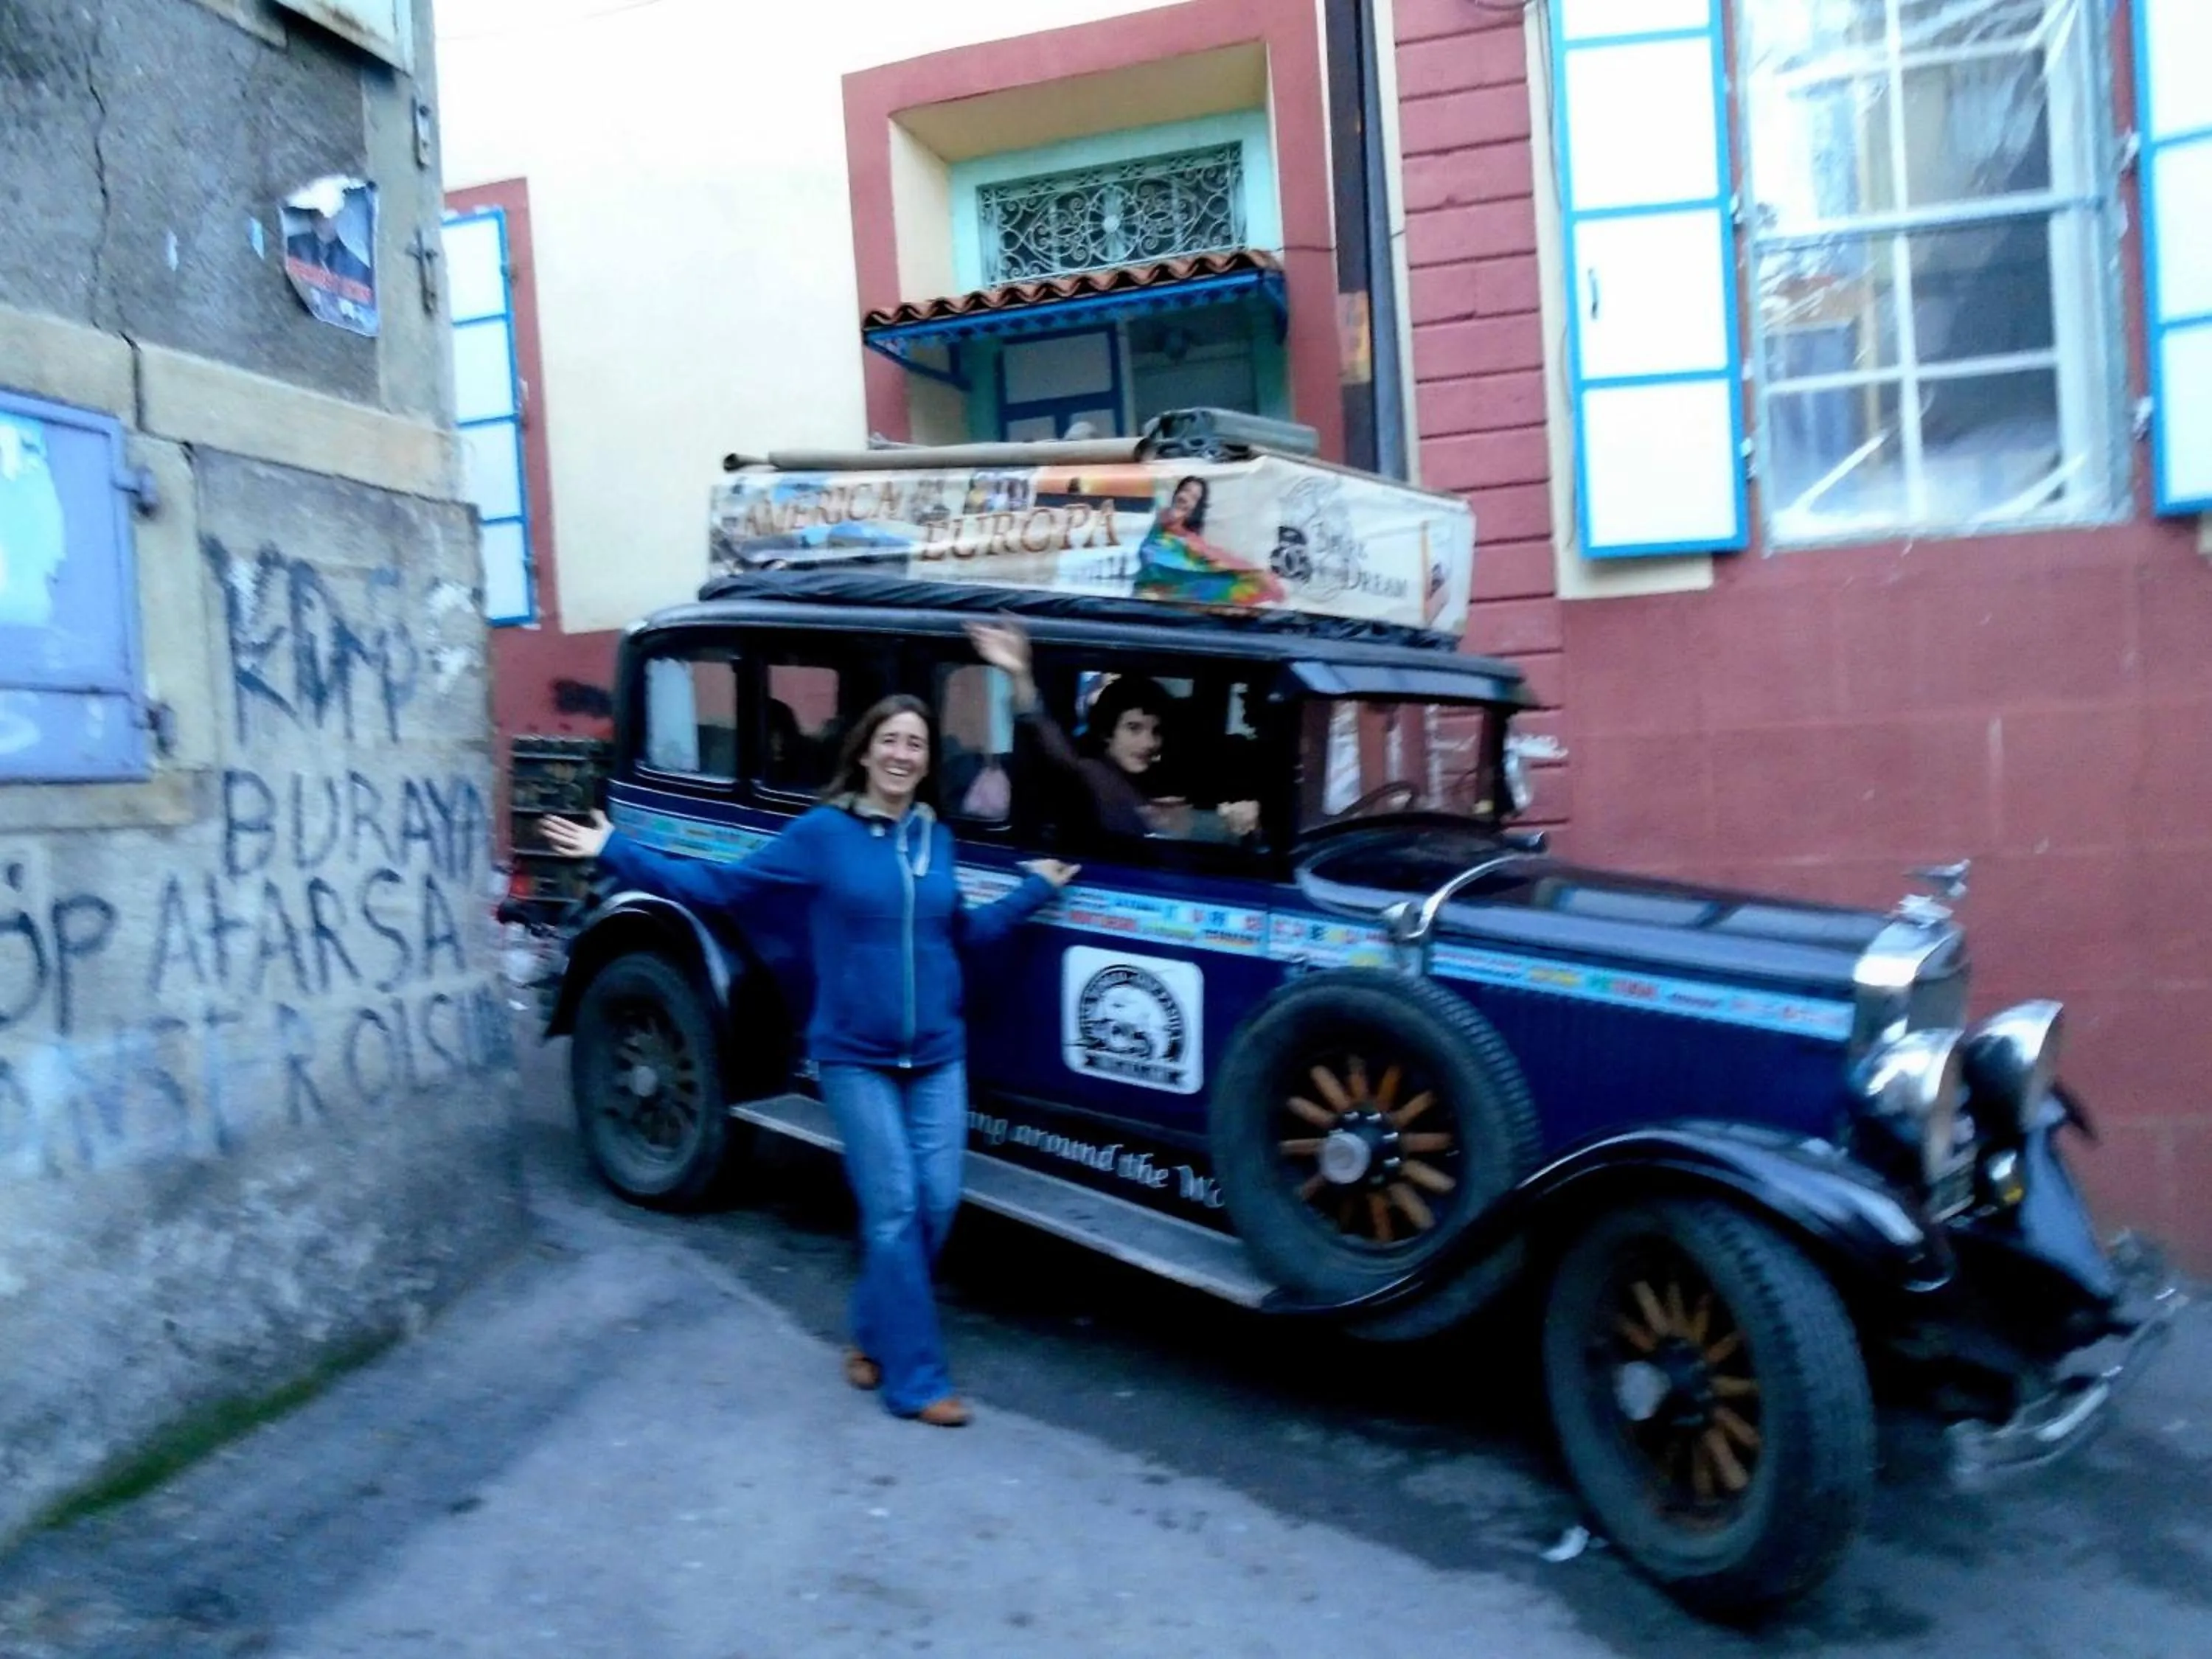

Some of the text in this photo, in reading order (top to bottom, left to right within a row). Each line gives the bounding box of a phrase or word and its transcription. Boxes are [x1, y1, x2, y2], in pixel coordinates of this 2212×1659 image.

[920, 498, 1121, 561] EUROPA
[1009, 1125, 1124, 1172] around
[1117, 1153, 1169, 1189] the
